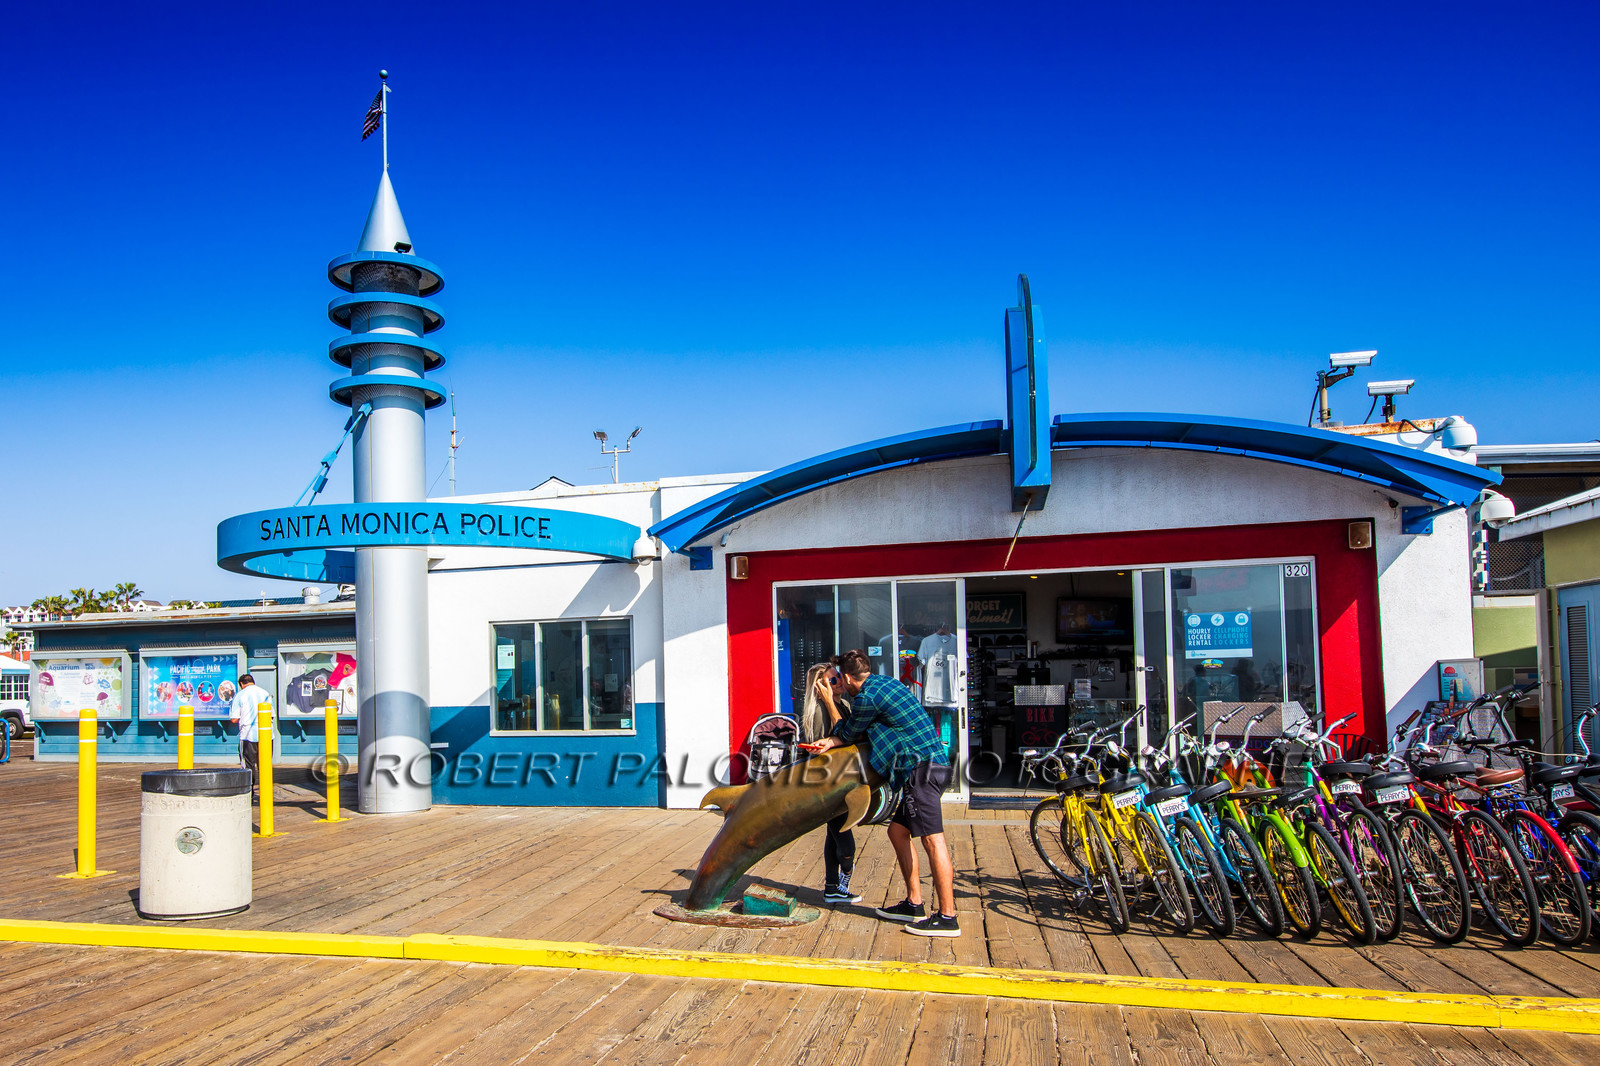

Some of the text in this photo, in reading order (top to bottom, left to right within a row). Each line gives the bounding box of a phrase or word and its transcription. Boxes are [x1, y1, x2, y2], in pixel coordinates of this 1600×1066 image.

[260, 511, 551, 541] SANTA MONICA POLICE
[1286, 564, 1308, 577] 320
[966, 600, 1000, 610] ORGET
[966, 609, 1014, 625] elmet!
[1213, 626, 1249, 634] CELLPHONE
[1213, 632, 1249, 640] CHARGING
[1188, 639, 1212, 647] RENTAL
[1213, 638, 1249, 646] LOCKERS
[48, 664, 80, 672] Aquarium
[169, 663, 222, 674] PACIFIC PARK
[1026, 707, 1056, 722] BIKE
[1335, 783, 1360, 792] PERRY'S
[1380, 790, 1407, 802] PERRY'S
[1116, 795, 1139, 809] PERRY'S
[1162, 802, 1186, 814] PERRY'S
